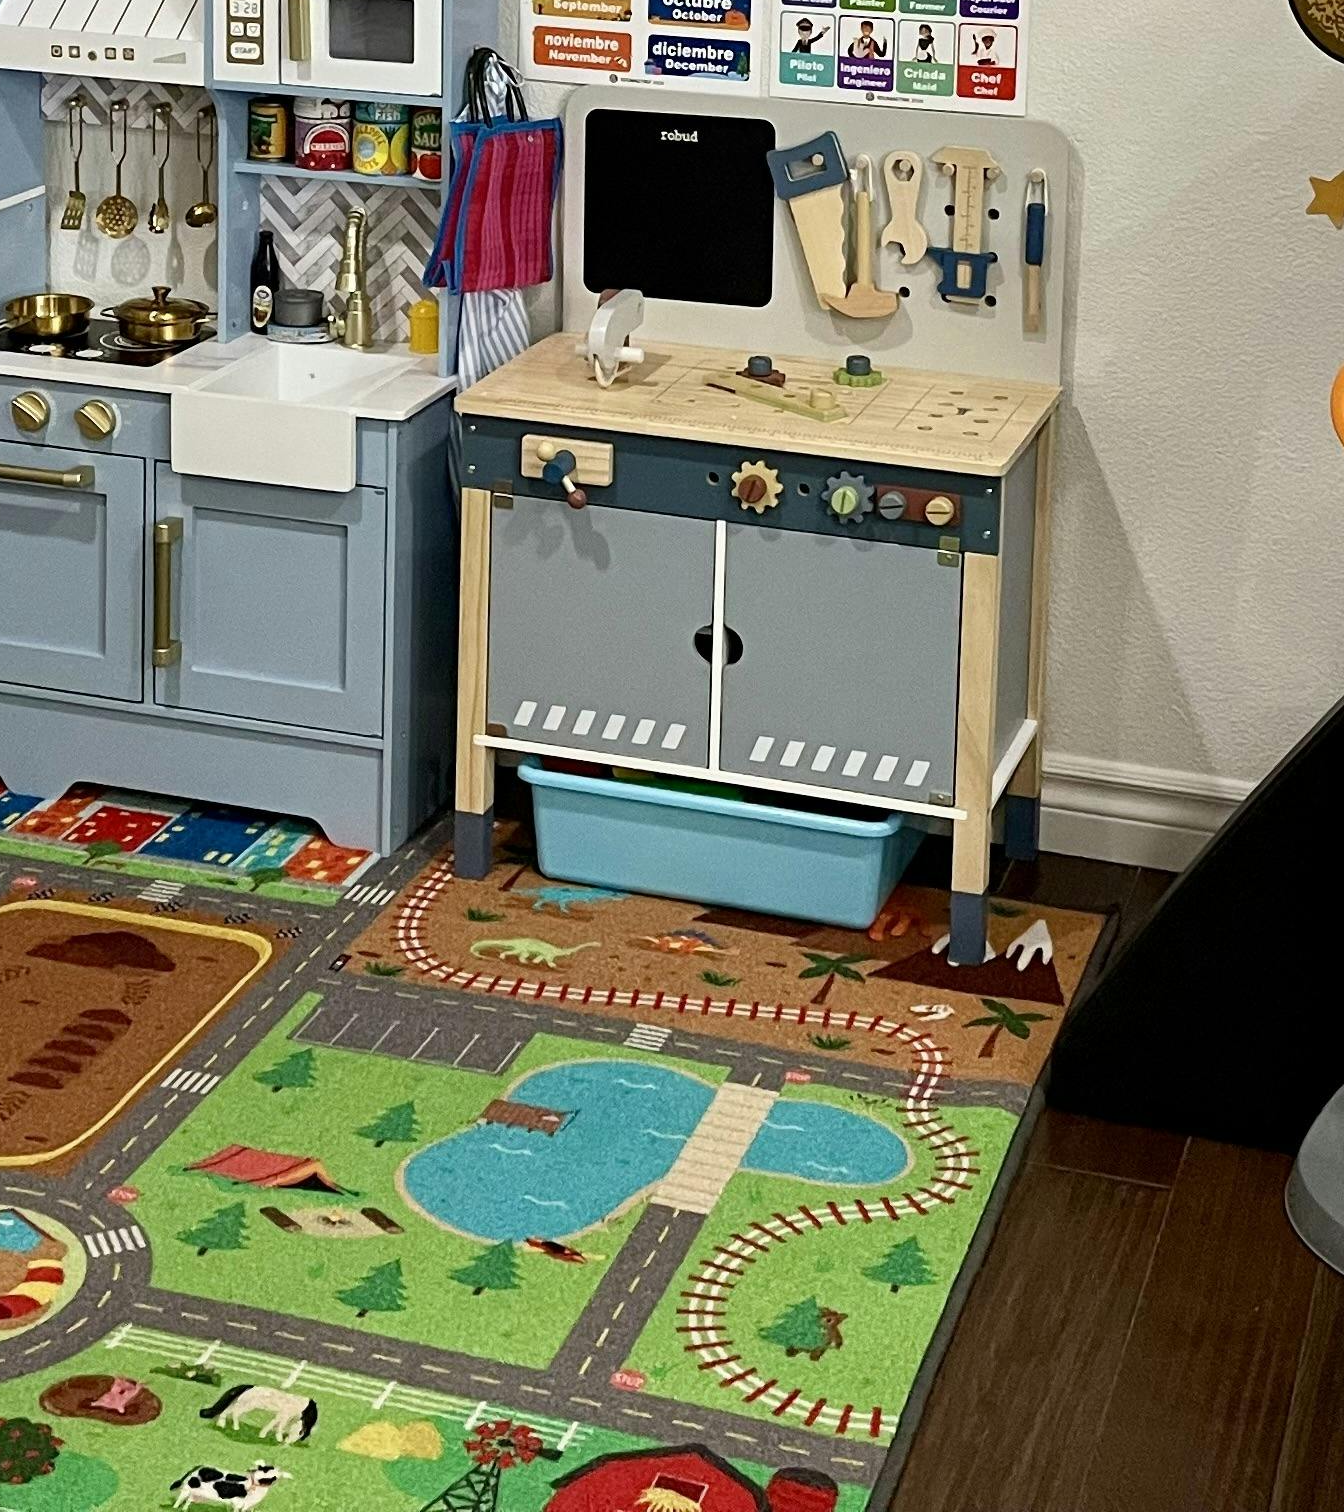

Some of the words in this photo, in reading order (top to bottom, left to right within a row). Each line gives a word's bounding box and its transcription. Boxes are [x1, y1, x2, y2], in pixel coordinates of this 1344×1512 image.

[909, 1, 946, 12] Farmer
[969, 5, 1008, 16] Courier
[672, 9, 723, 23] October
[544, 33, 619, 52] noviembre
[548, 49, 612, 65] November
[652, 42, 734, 61] diciembre
[665, 58, 729, 74] December
[789, 59, 824, 72] Piloto
[840, 63, 891, 77] Ingeniero
[796, 72, 817, 83] Pilot
[903, 68, 946, 81] Criada
[970, 72, 1002, 86] Chef
[843, 77, 887, 89] Engineer
[912, 81, 937, 92] Maid
[973, 86, 998, 97] Chef
[375, 110, 401, 121] Fish
[661, 129, 698, 142] robud
